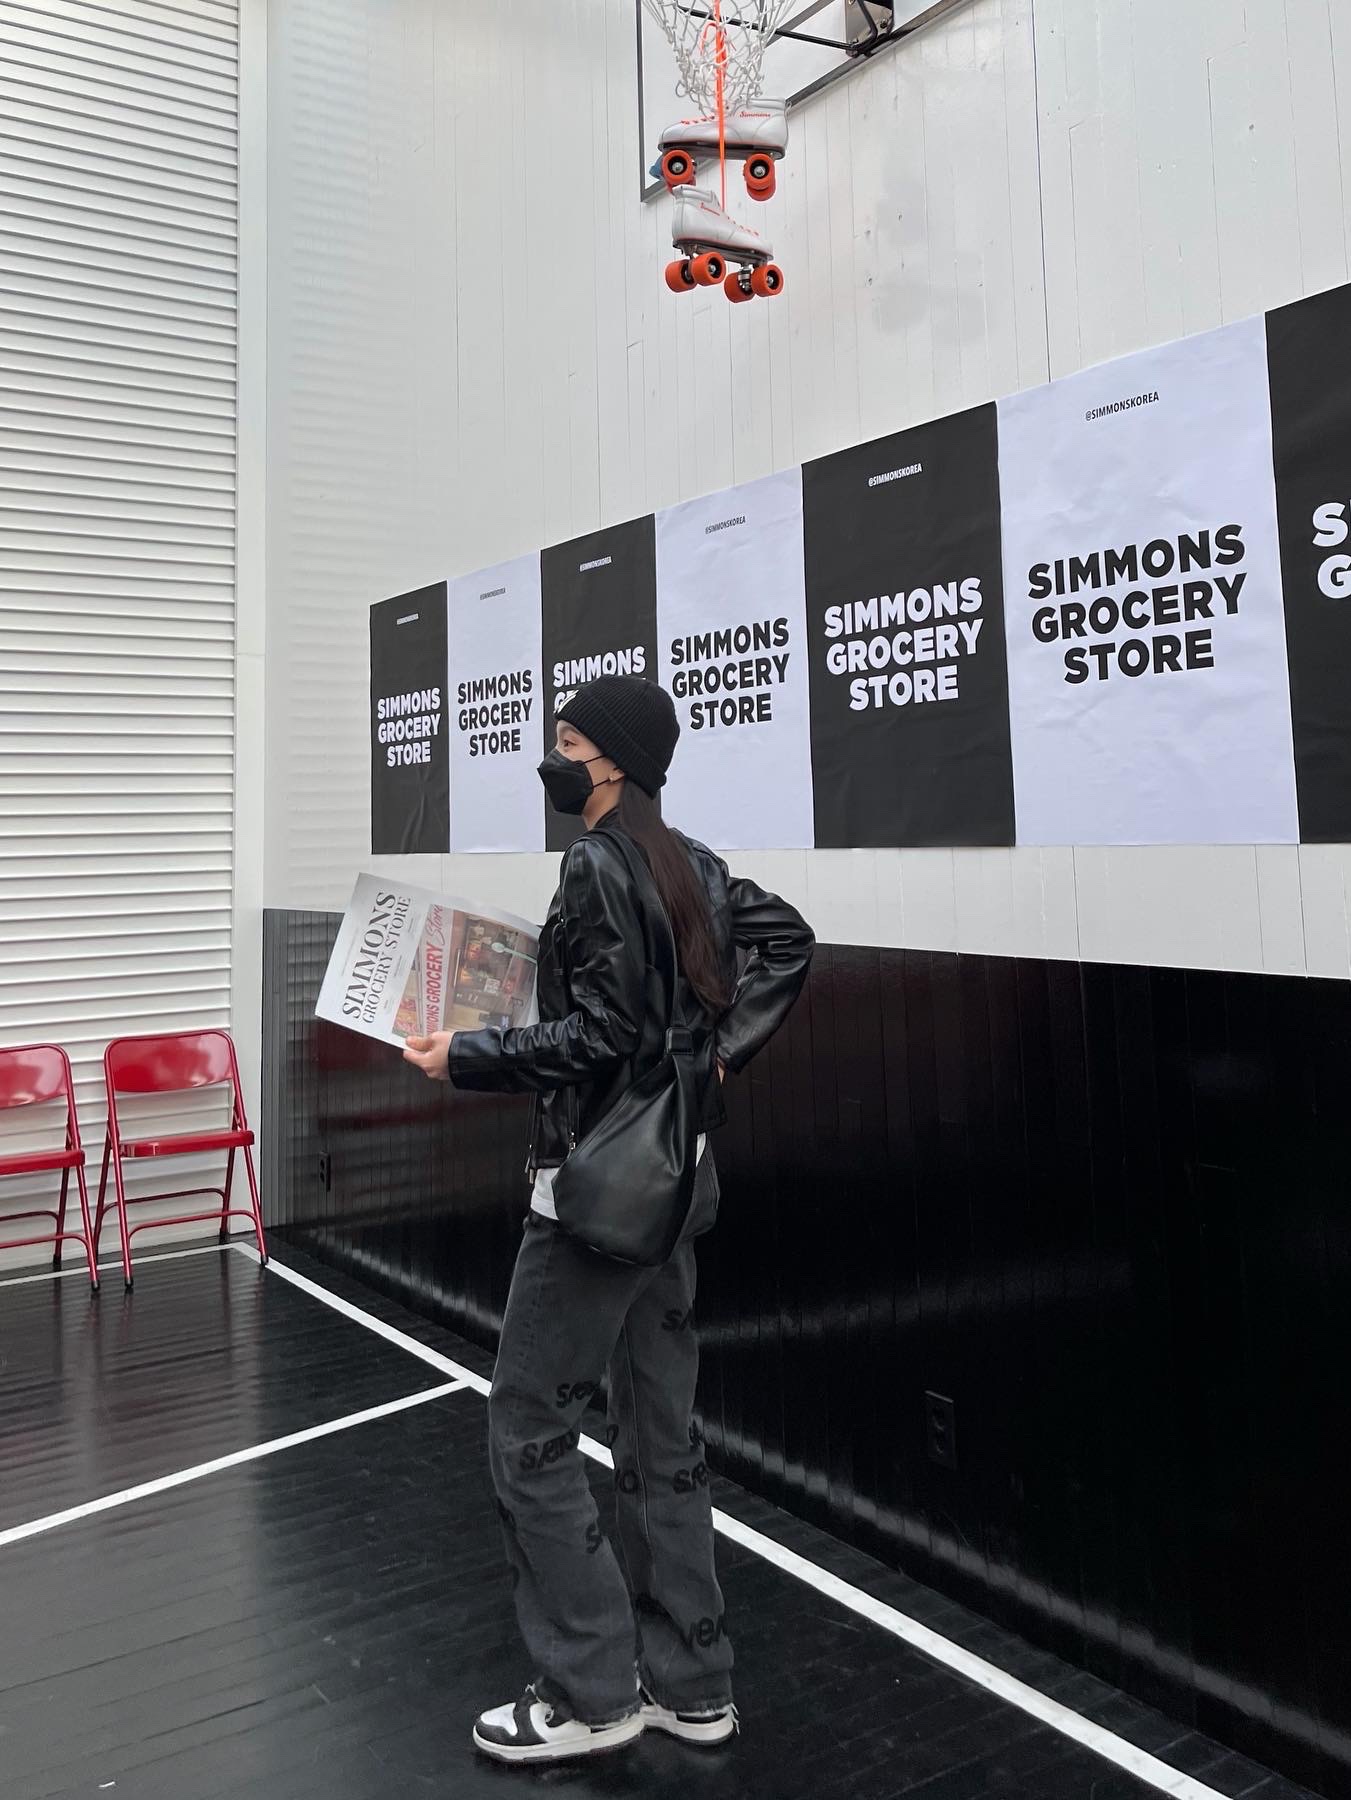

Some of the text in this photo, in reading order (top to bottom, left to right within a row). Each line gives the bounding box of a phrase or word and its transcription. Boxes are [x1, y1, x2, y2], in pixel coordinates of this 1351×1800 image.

[1085, 391, 1160, 421] @SIMMONSKOREA
[868, 463, 923, 488] @SIMMONSKOREA
[1027, 524, 1246, 599] SIMMONS
[824, 577, 984, 639] SIMMONS
[1031, 572, 1248, 643] GROCERY
[670, 618, 790, 666] SIMMONS
[826, 618, 985, 676] GROCERY
[1063, 628, 1215, 685] STORE
[457, 669, 534, 705] SIMMONS
[552, 645, 647, 688] SIMMONS
[671, 653, 790, 699] GROCERY
[849, 665, 959, 712] STORE
[377, 687, 441, 720] SIMMONS
[458, 698, 534, 731] GROCERY
[690, 693, 772, 731] STORE
[377, 713, 441, 744] GROCERY
[469, 729, 522, 757] STORE
[386, 744, 432, 768] STORE
[342, 891, 397, 1019] SIMMONS
[362, 896, 412, 1024] GROCERY STORE
[425, 943, 444, 1003] GROCERY
